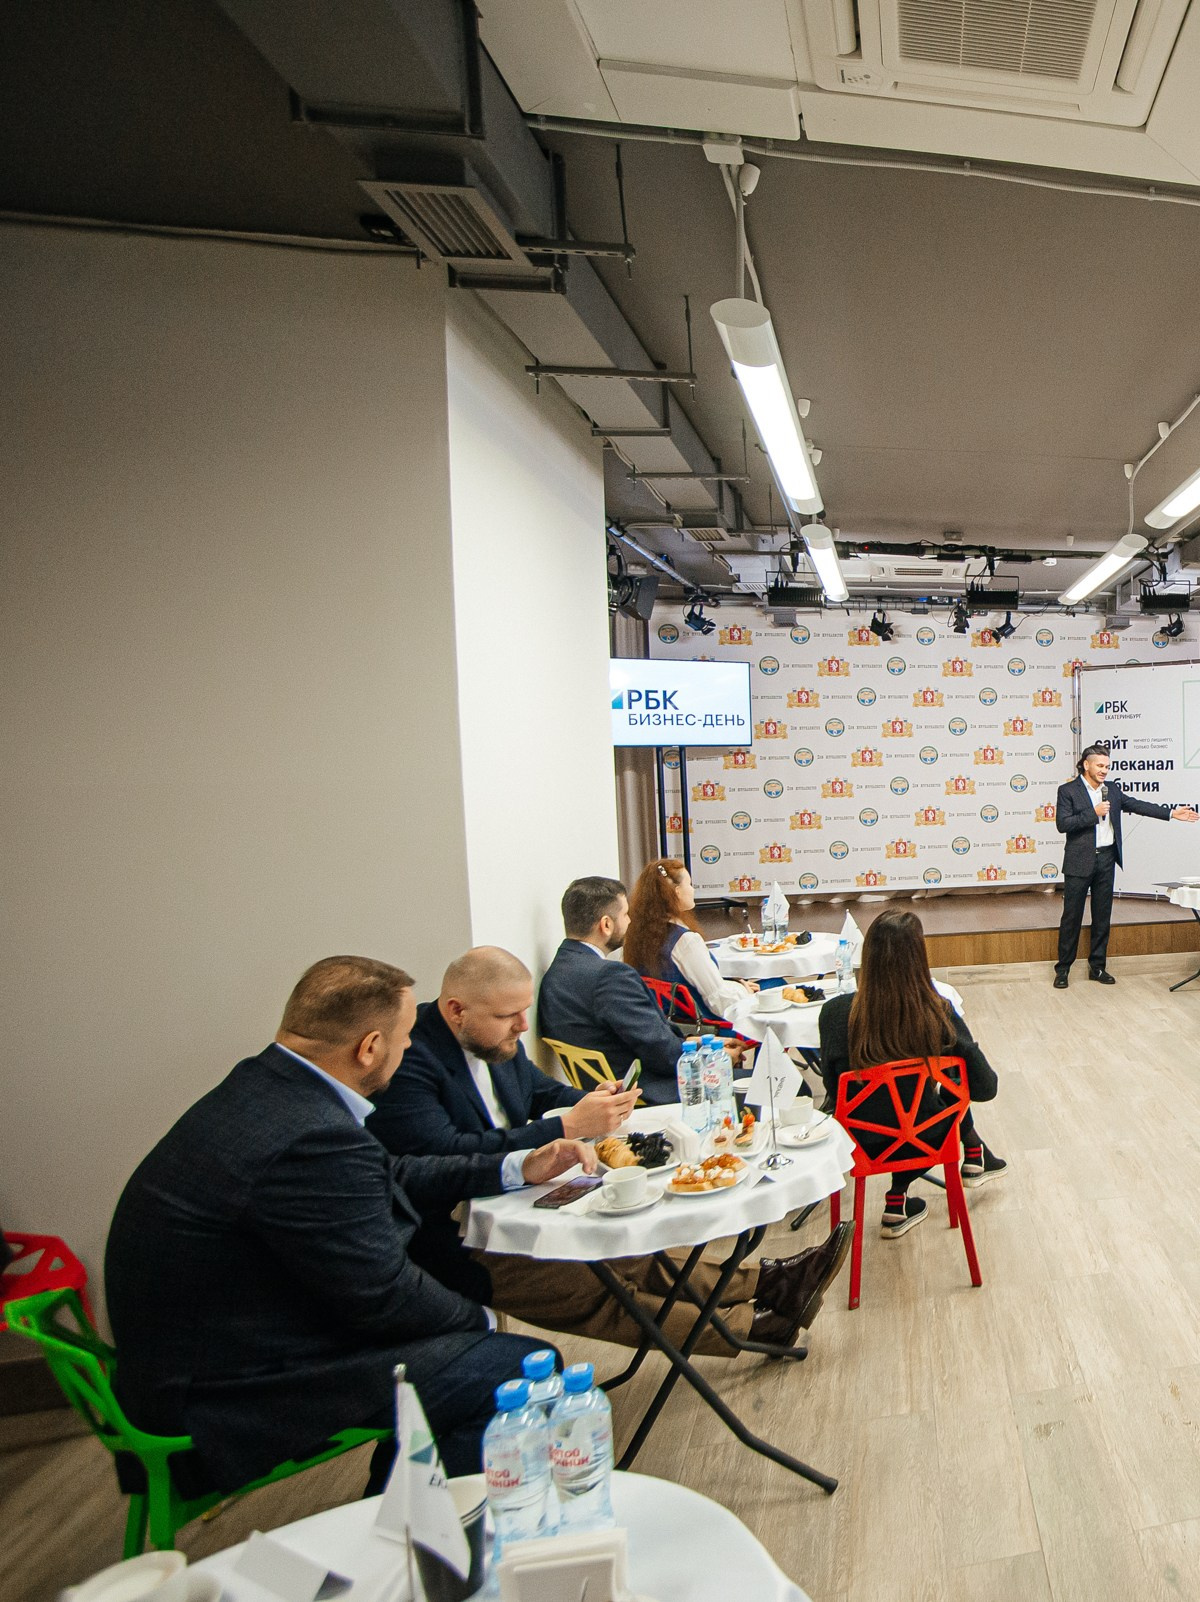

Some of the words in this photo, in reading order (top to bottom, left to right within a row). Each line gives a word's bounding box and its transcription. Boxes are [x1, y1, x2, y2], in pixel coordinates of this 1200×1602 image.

[628, 690, 680, 710] РБК
[1105, 700, 1128, 713] РБК
[628, 713, 745, 728] БИЗНЕС-ДЕНЬ
[1095, 736, 1128, 749] сайт
[1109, 759, 1174, 770] леканал
[1114, 778, 1159, 792] бытия
